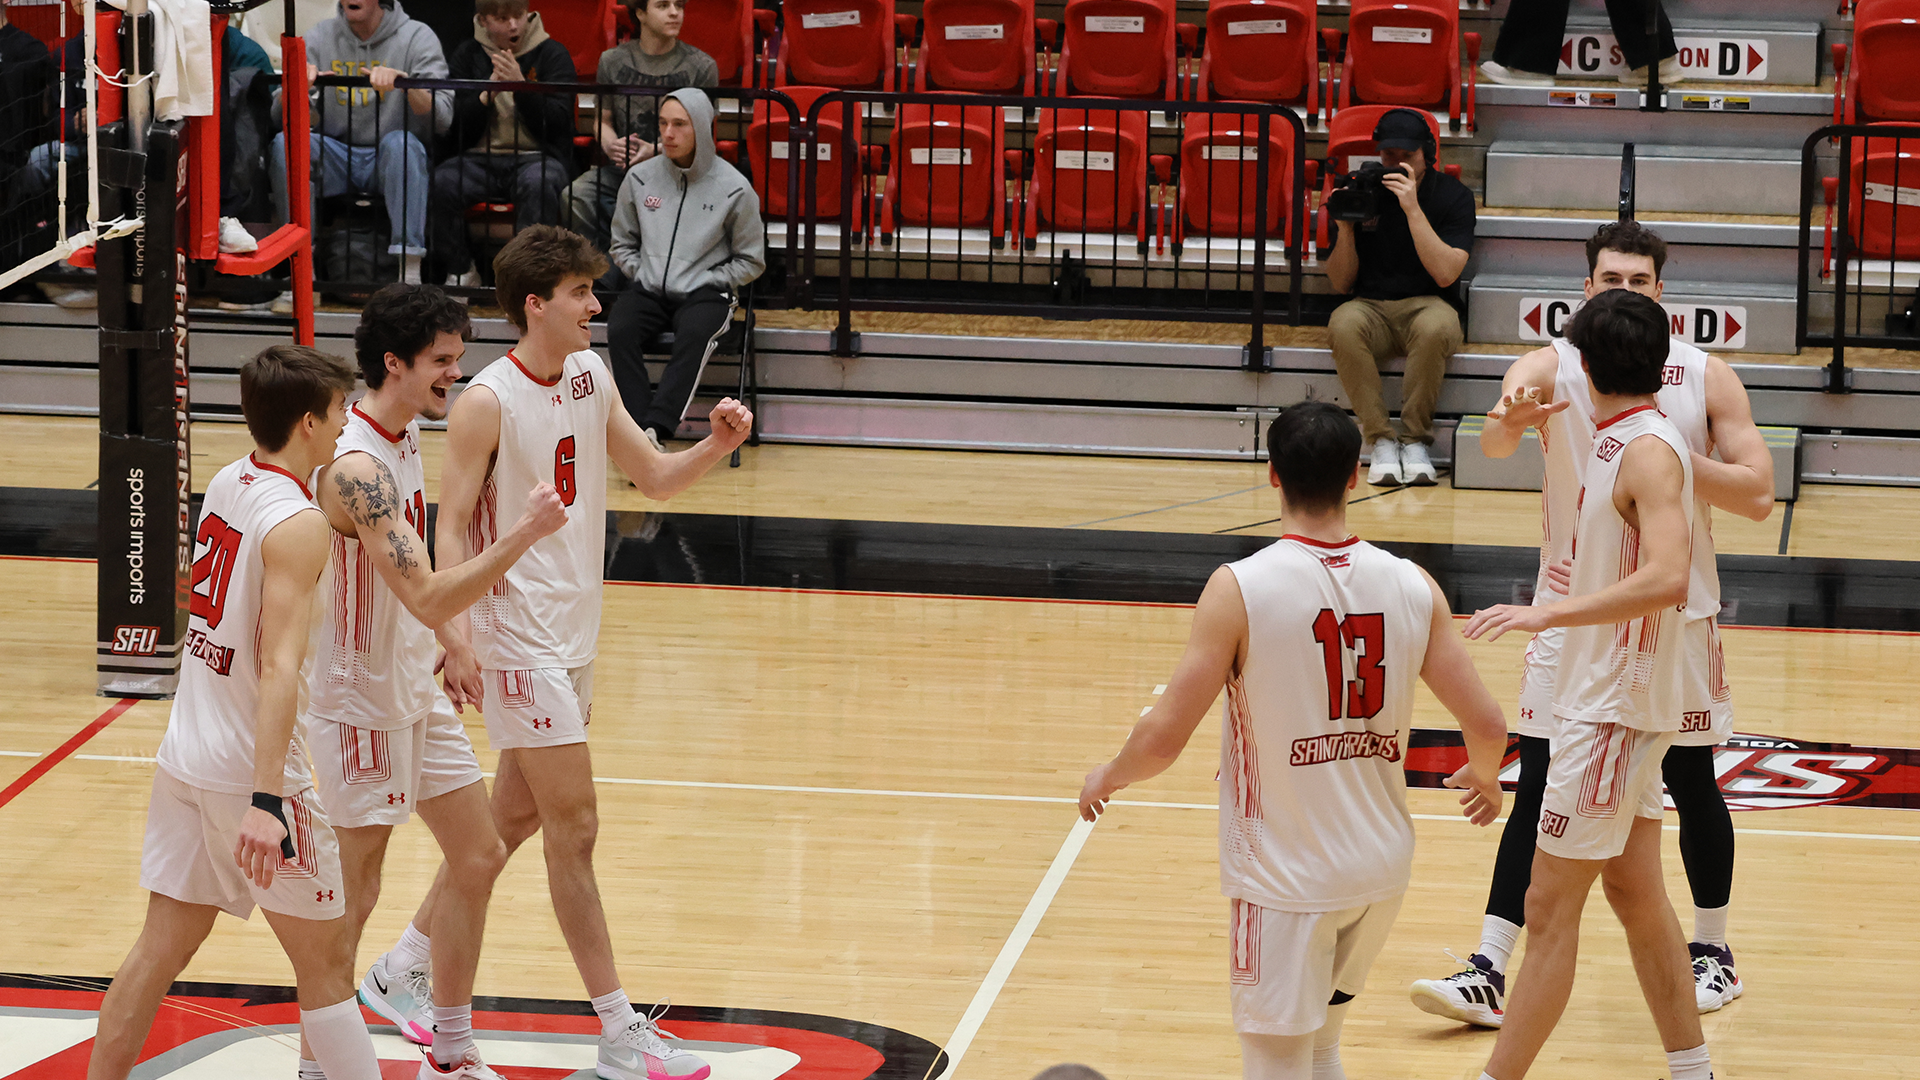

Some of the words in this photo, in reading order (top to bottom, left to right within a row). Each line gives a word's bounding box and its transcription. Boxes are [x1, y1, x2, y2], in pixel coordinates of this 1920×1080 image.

[1577, 36, 1601, 72] C
[1717, 42, 1741, 76] D
[1694, 307, 1718, 344] D
[571, 370, 594, 401] SFU
[1597, 436, 1625, 463] SFU
[554, 434, 577, 508] 6
[126, 467, 146, 528] sports
[126, 530, 146, 605] imports
[190, 511, 244, 631] 20
[112, 626, 160, 656] SFU
[1311, 608, 1386, 720] 13
[1679, 710, 1711, 733] SFU
[1290, 734, 1343, 766] SAINT
[1541, 809, 1570, 839] SFU
